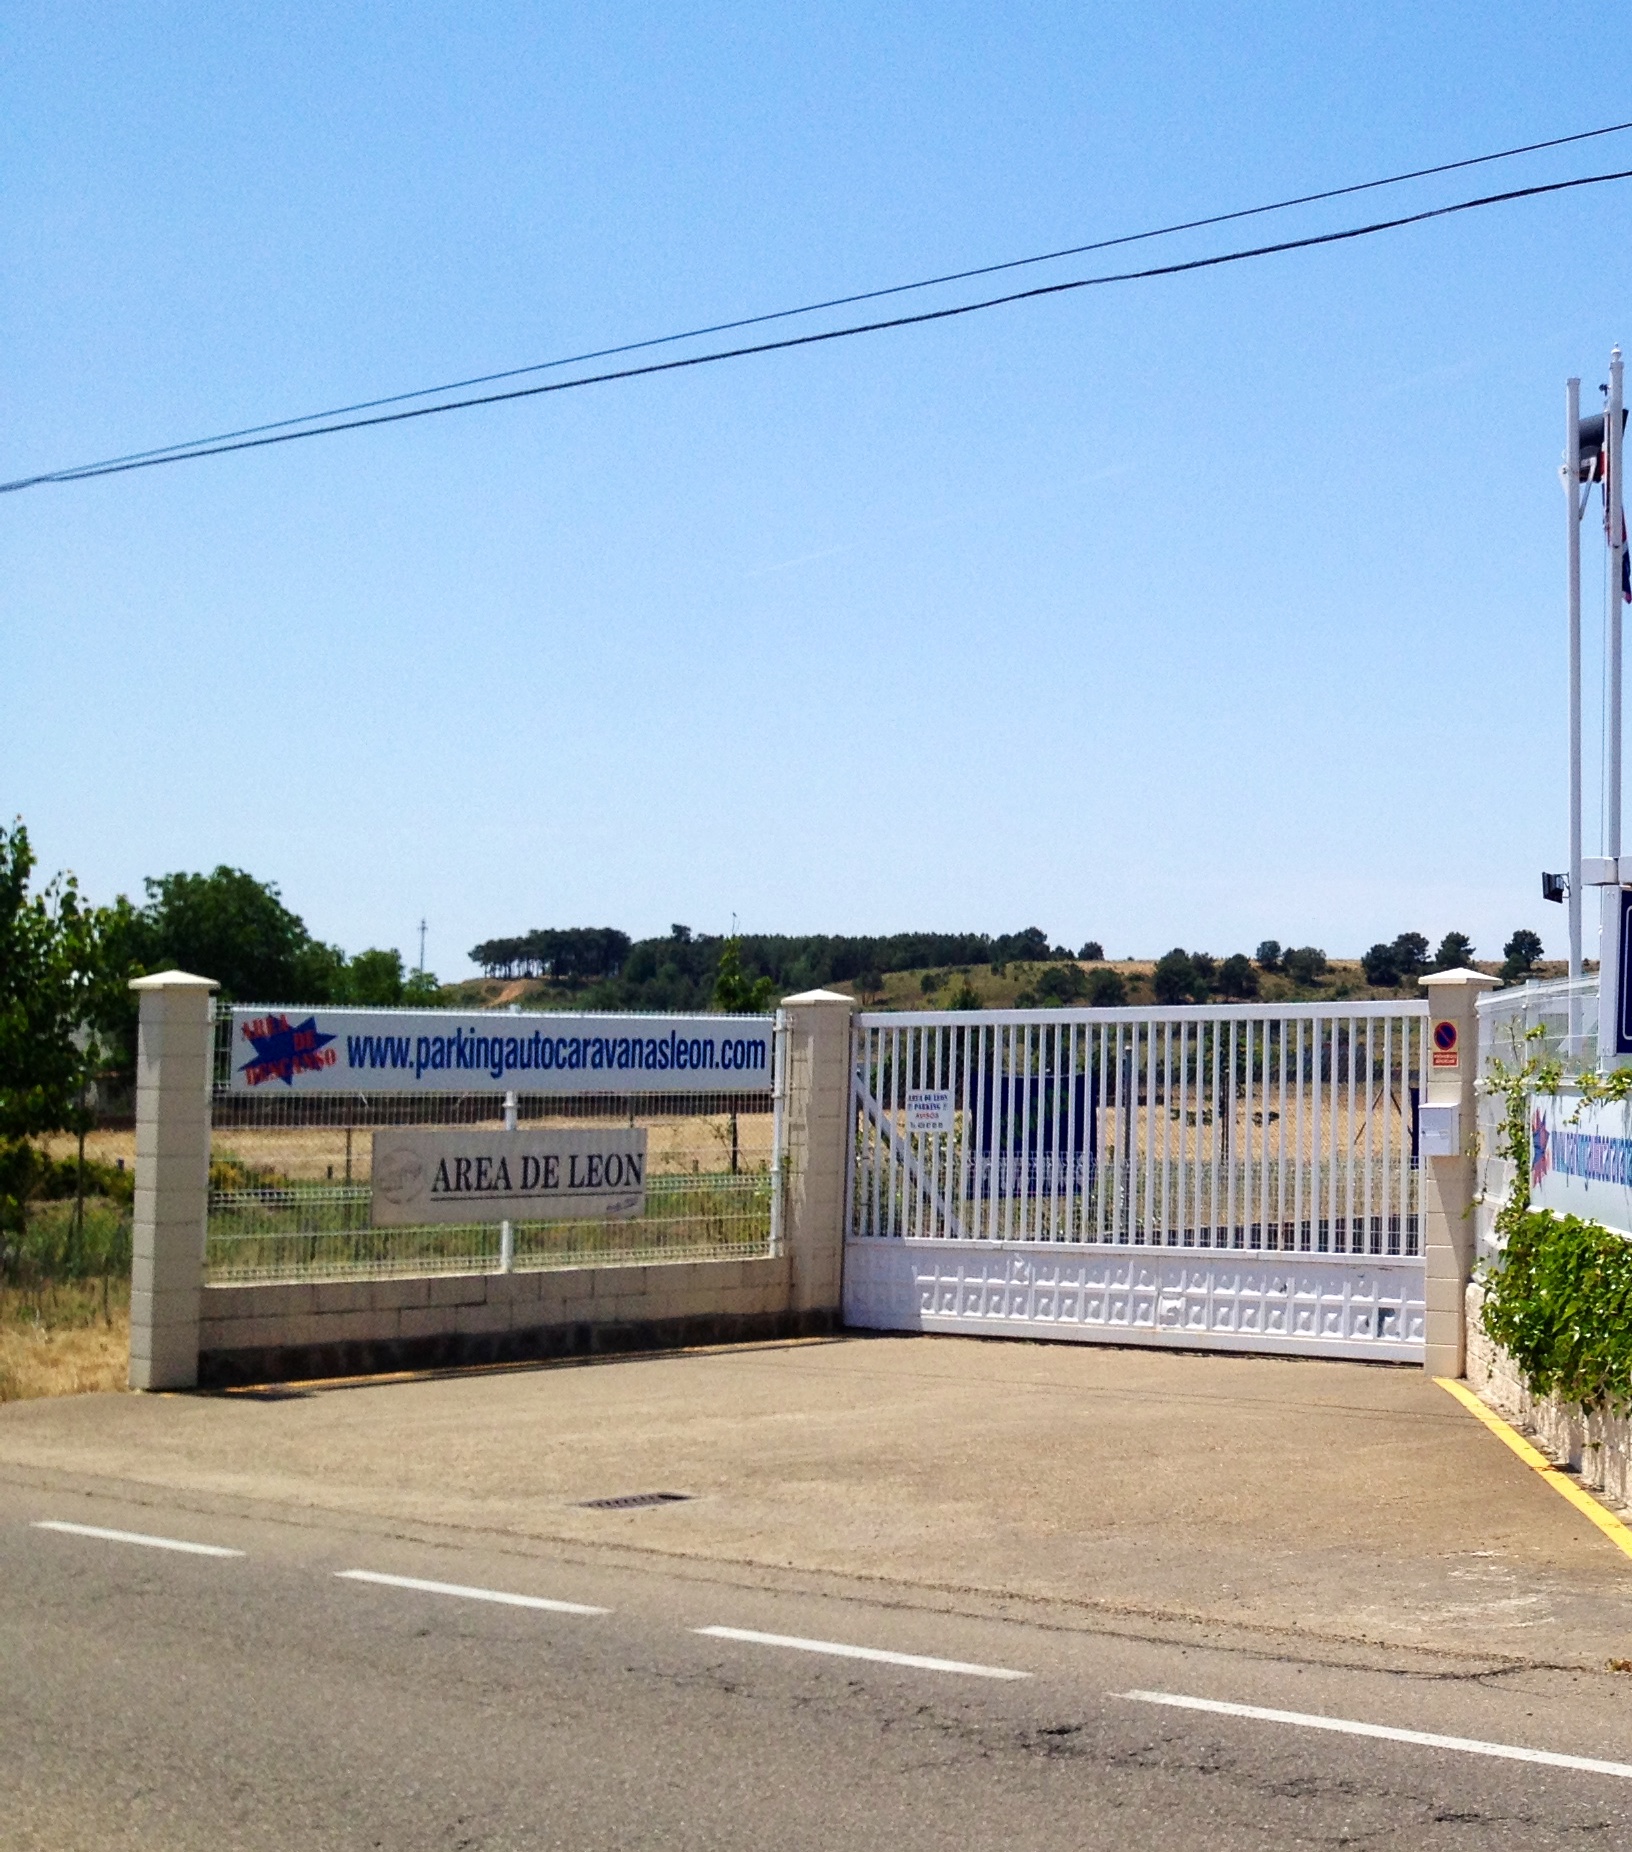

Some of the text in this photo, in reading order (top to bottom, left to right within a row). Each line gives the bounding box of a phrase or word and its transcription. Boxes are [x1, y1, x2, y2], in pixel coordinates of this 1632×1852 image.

[241, 1014, 289, 1040] AREA
[347, 1026, 766, 1080] www.parkingautocaravanasleon.com
[431, 1153, 644, 1193] AREA DE LEON
